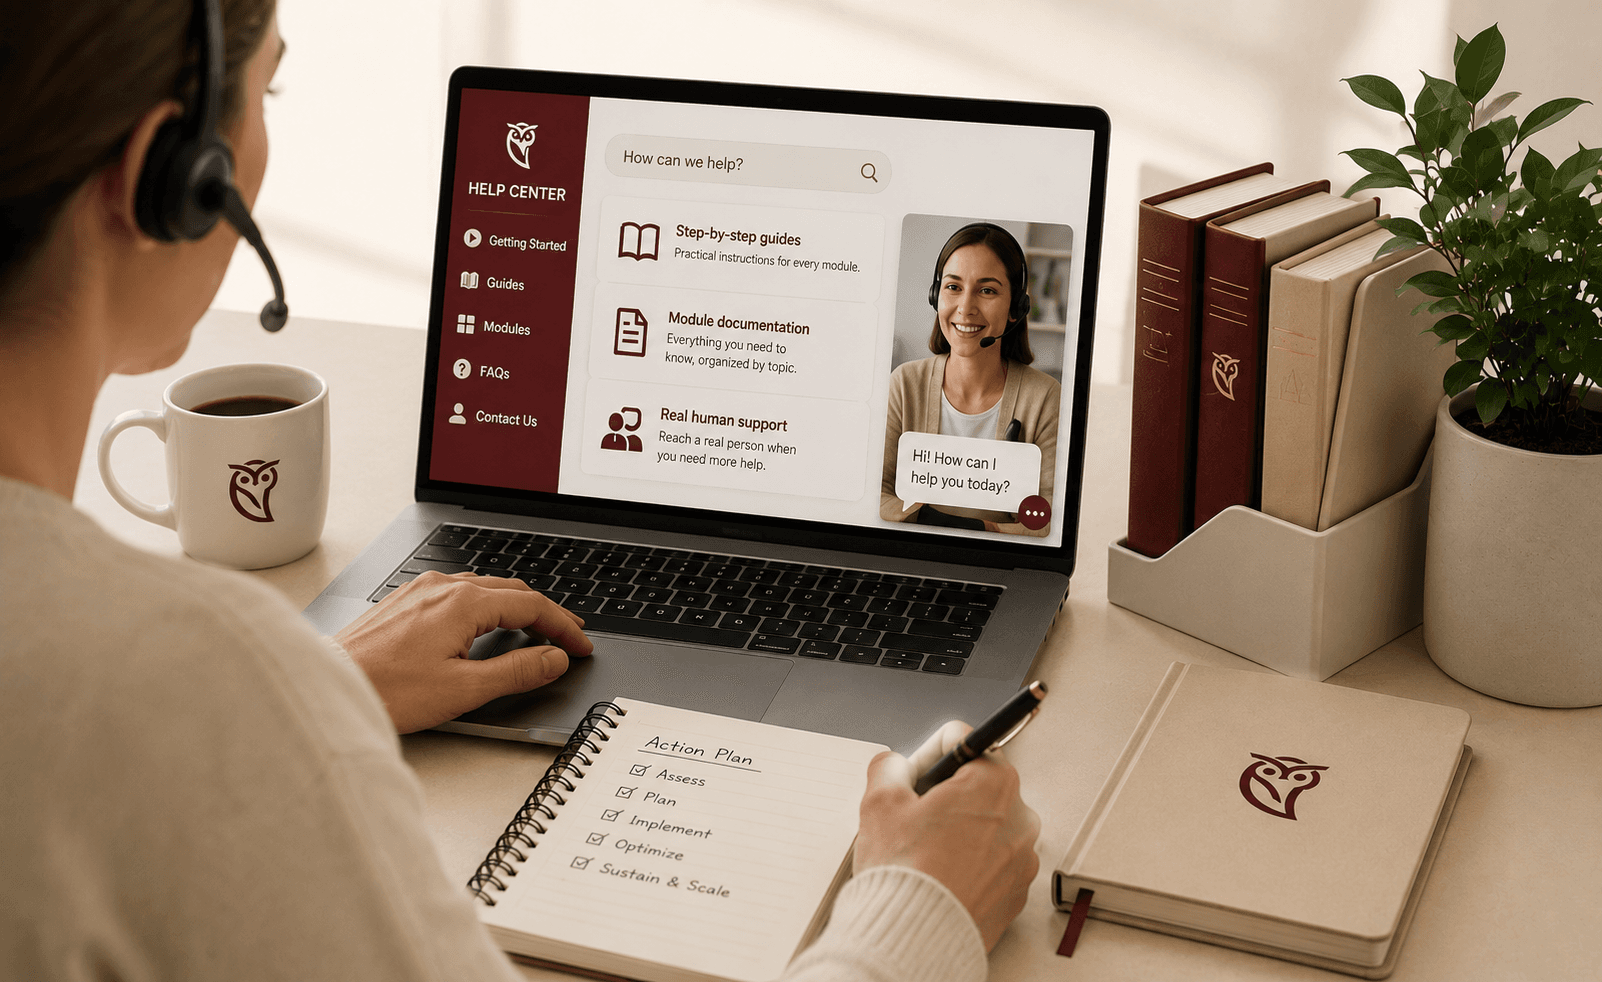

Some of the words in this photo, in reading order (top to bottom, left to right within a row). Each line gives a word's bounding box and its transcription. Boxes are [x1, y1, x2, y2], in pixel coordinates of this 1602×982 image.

[623, 150, 653, 165] How
[657, 155, 680, 167] can
[684, 158, 703, 168] we
[707, 156, 744, 173] help?
[468, 182, 506, 196] HELP
[509, 185, 566, 201] CENTER
[489, 235, 527, 251] Getting
[529, 238, 567, 251] Started
[676, 224, 757, 245] Step-by-step
[760, 231, 801, 246] guides
[674, 248, 716, 261] Practical
[719, 251, 775, 266] instructions
[777, 256, 791, 267] for
[793, 258, 819, 271] every
[822, 260, 861, 273] module.
[487, 277, 525, 291] Guides
[484, 321, 530, 336] Modules
[668, 311, 714, 327] Module
[717, 315, 810, 335] documentation
[667, 333, 722, 351] Everything
[725, 340, 744, 352] you
[746, 340, 773, 353] need
[776, 344, 786, 354] to
[480, 366, 510, 380] FAQs
[665, 351, 695, 366] know,
[698, 355, 749, 369] organized
[752, 359, 765, 372] by
[768, 361, 797, 375] topic.
[476, 410, 520, 426] Contact
[523, 414, 538, 427] Us
[660, 408, 688, 422] Real
[691, 410, 735, 427] human
[738, 416, 788, 433] support
[659, 431, 692, 445] Reach
[694, 436, 701, 445] a
[704, 435, 724, 448] real
[727, 439, 764, 453] person
[768, 442, 797, 455] when
[657, 452, 676, 463] you
[680, 453, 706, 465] need
[709, 456, 737, 468] more
[740, 458, 766, 472] help.
[913, 449, 931, 463] Hi!
[934, 452, 963, 466] How
[966, 456, 989, 470] can
[992, 458, 997, 470] I
[911, 470, 938, 487] help
[941, 477, 964, 489] you
[967, 478, 1011, 495] today?
[645, 736, 705, 757] Action
[715, 748, 752, 765] Plan
[656, 769, 706, 787] Assess
[643, 792, 676, 807] Plan
[629, 815, 713, 839] Implement
[615, 839, 684, 861] Optimize
[599, 863, 660, 884] Sustain
[666, 877, 679, 888] &
[687, 880, 730, 898] Scale
